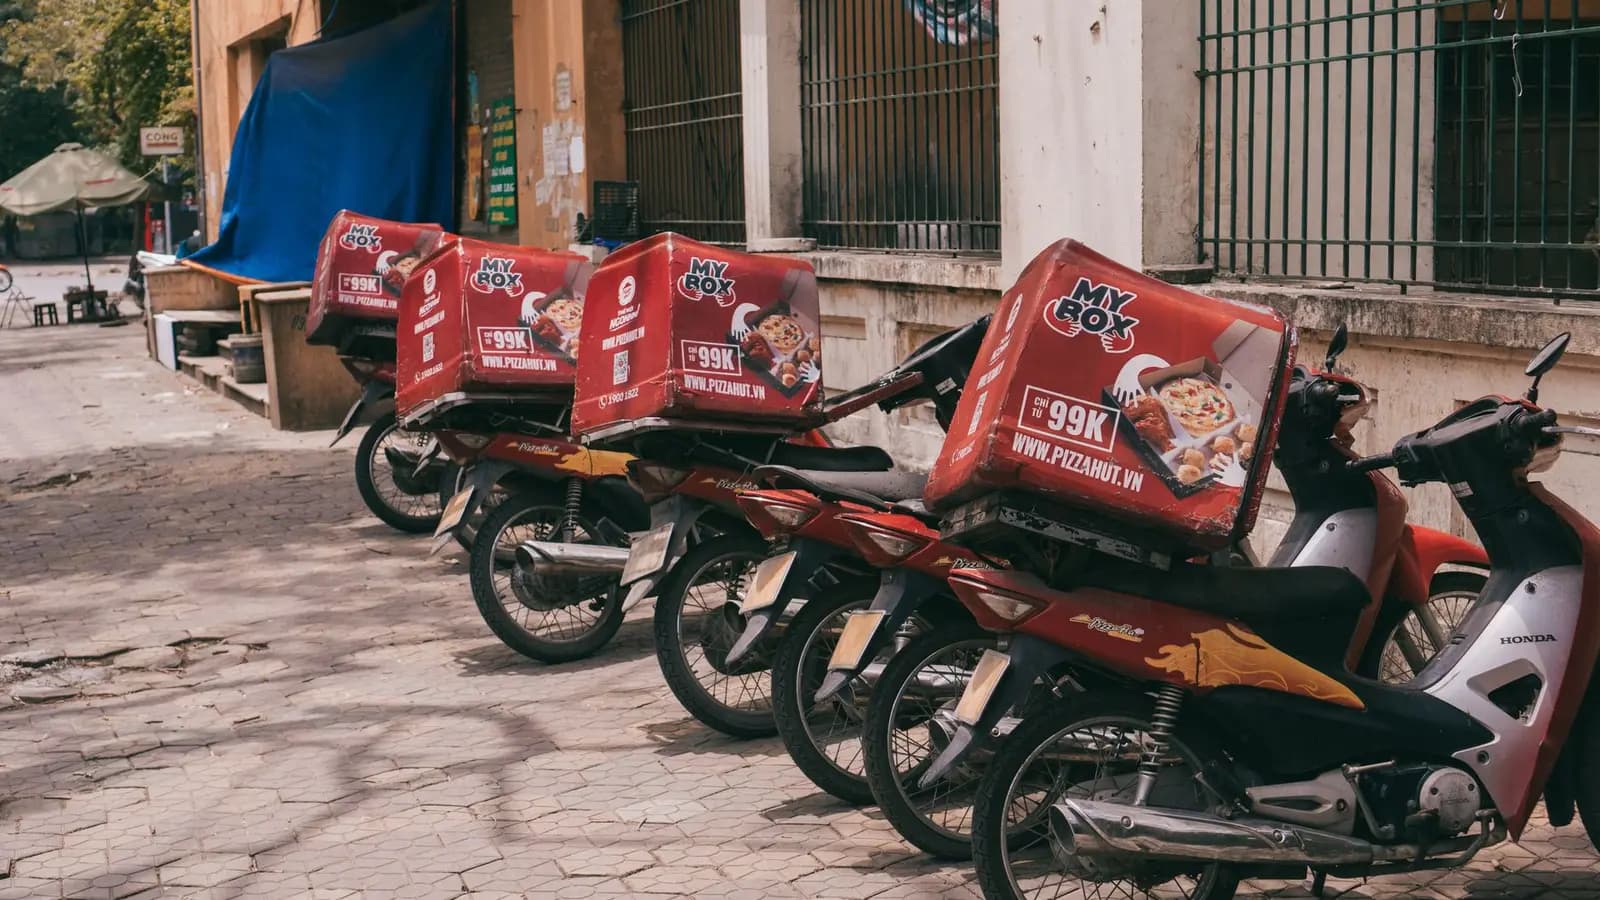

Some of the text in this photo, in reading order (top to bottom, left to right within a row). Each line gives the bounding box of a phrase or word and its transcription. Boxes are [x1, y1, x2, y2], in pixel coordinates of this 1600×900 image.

[343, 233, 383, 247] BOX
[350, 224, 379, 236] MY
[481, 257, 516, 273] MY
[690, 257, 729, 279] MY
[351, 277, 377, 292] 99K
[475, 270, 522, 288] BOX
[683, 272, 736, 296] BOX
[1071, 277, 1137, 314] MY
[1053, 296, 1140, 340] BOX
[493, 330, 528, 349] 99K
[482, 355, 557, 371] WWW.PIZZAHUT.VN
[698, 346, 735, 371] 99K
[683, 374, 766, 400] WWW.PIZZAHUT.VN
[1047, 400, 1108, 442] 99K
[1012, 432, 1144, 492] WWW.PIZZAHUT.VN
[1500, 634, 1557, 645] HONDA
